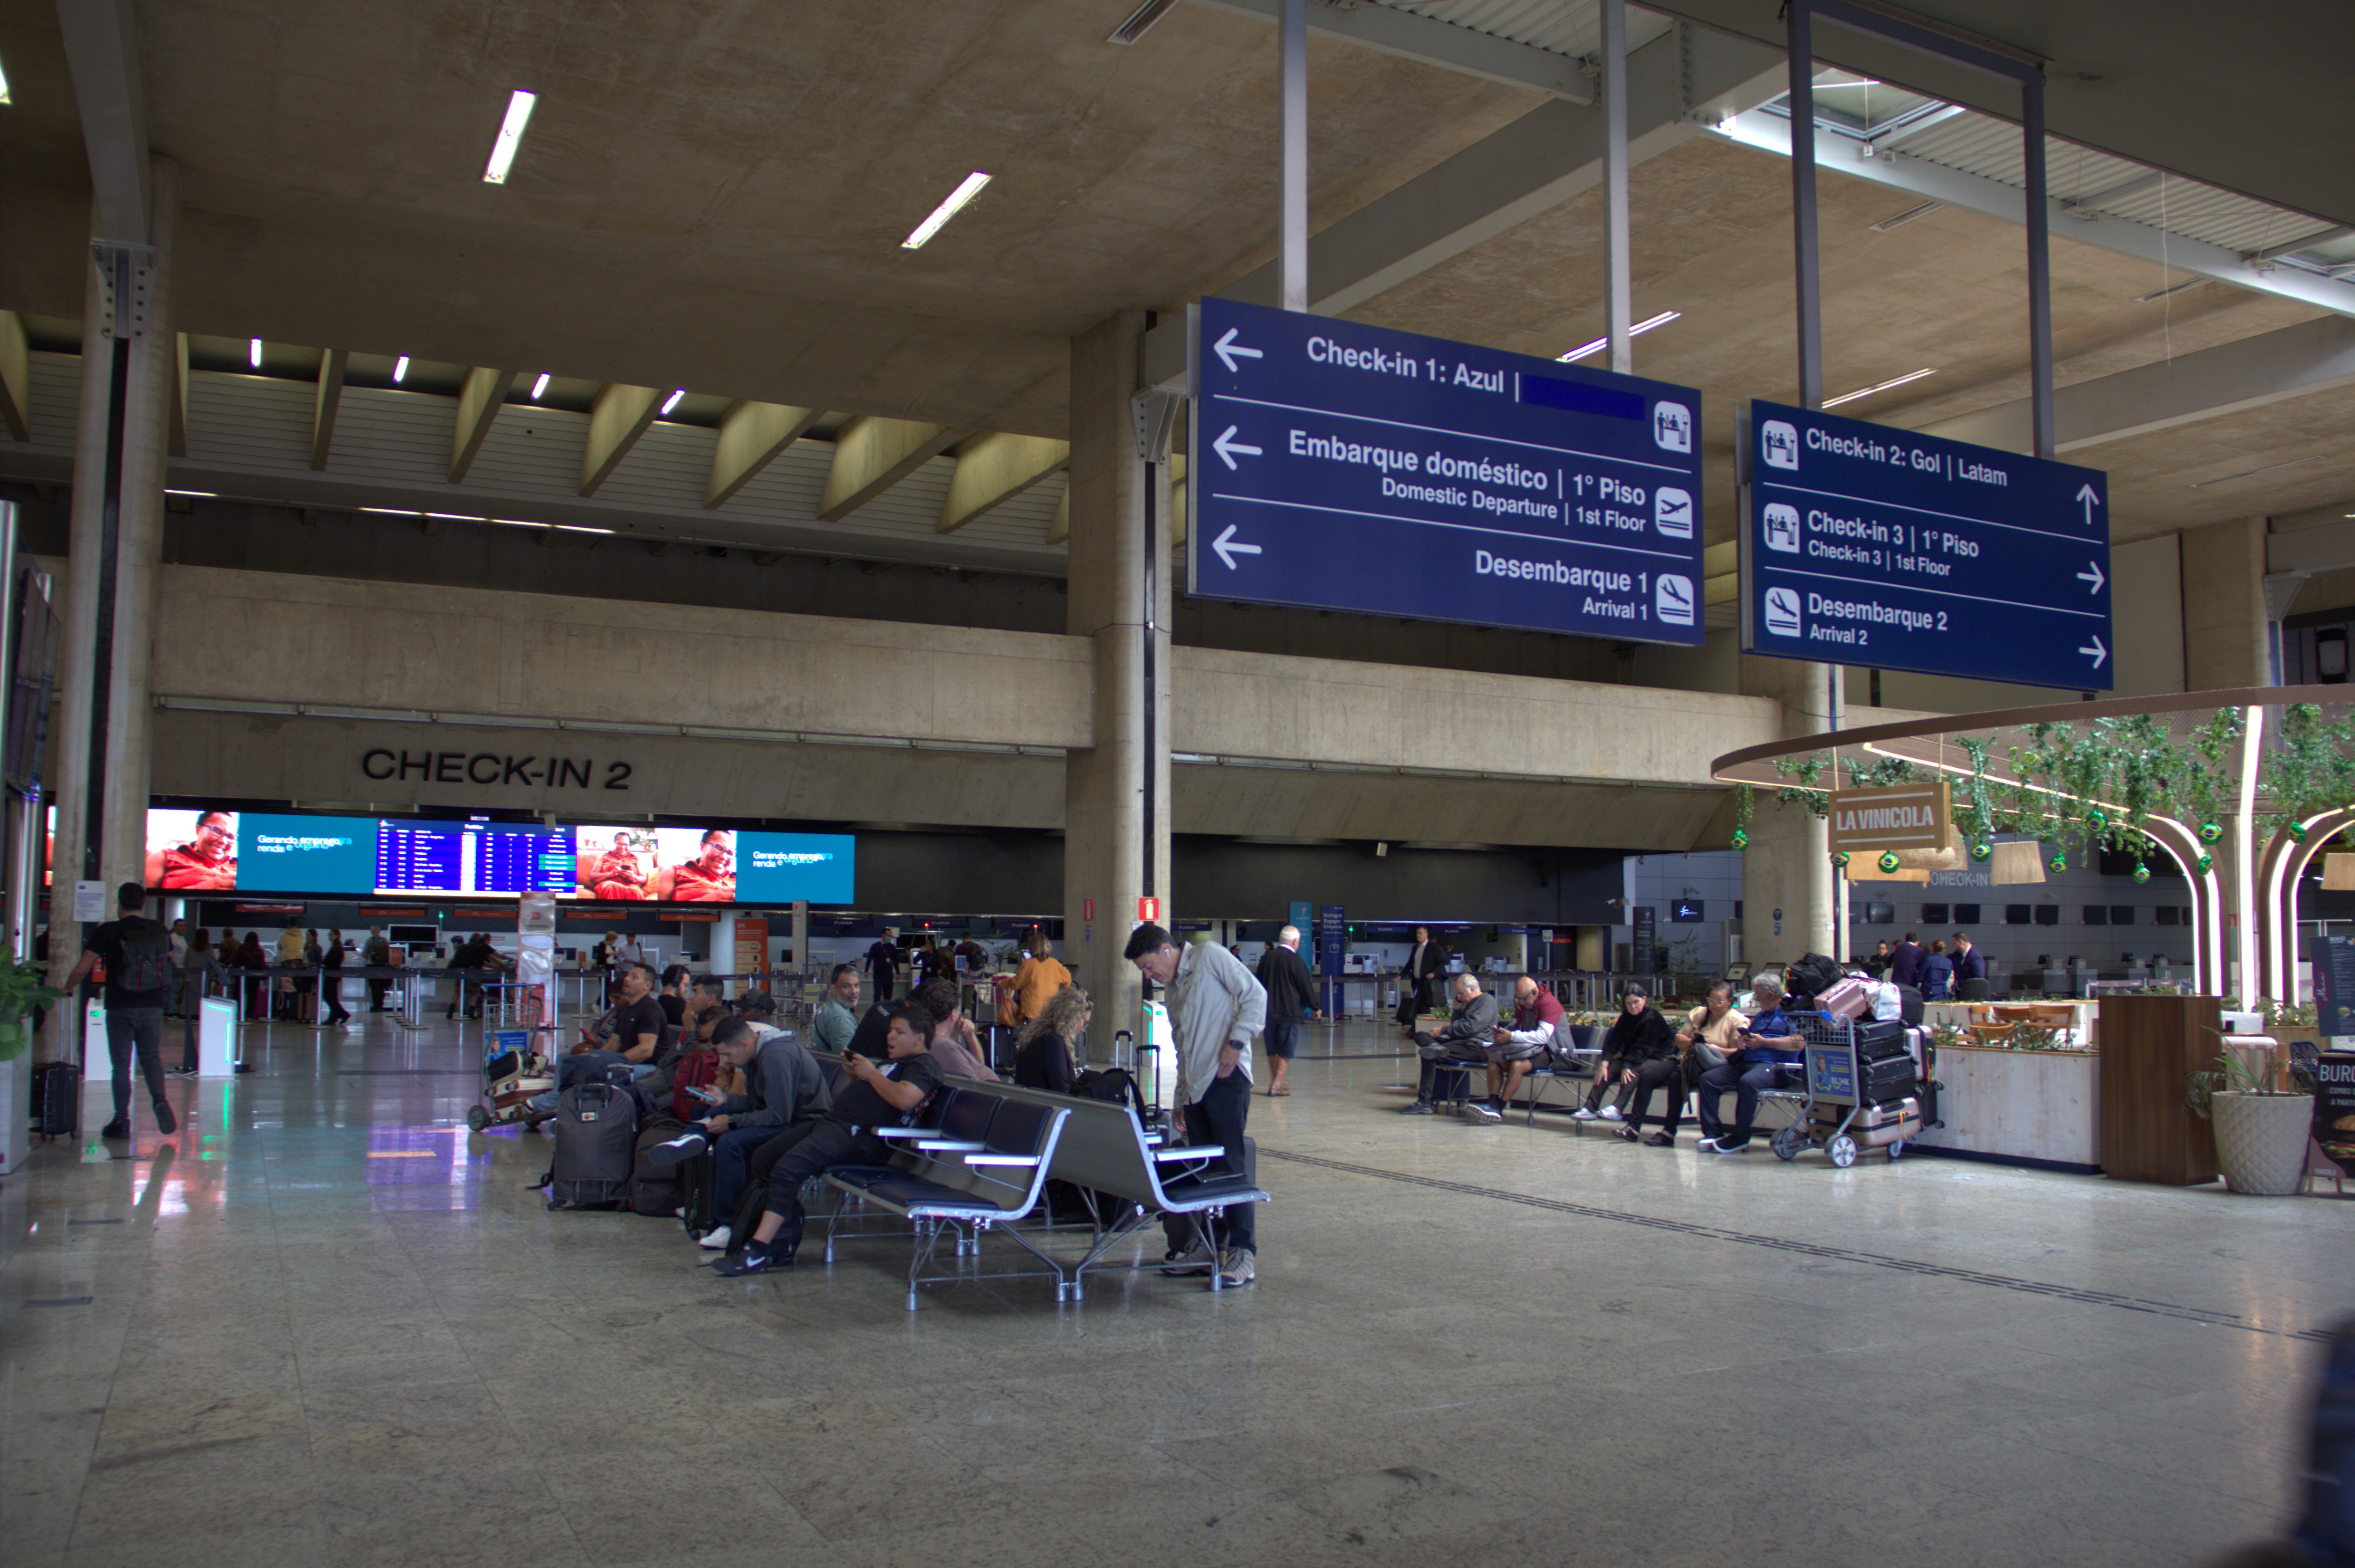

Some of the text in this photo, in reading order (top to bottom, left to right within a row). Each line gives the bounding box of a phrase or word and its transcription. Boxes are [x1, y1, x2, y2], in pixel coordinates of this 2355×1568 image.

[1307, 336, 1504, 393] Check-in 1: Azul
[1290, 430, 1418, 472] Embarque
[1426, 452, 1547, 490] doméstico
[1600, 478, 1646, 505] Piso
[1806, 428, 2007, 486] Check-in 2: Gol Latam
[1383, 478, 1646, 531] Domestic Departure 1st Floor
[1808, 510, 1888, 542] Check-in
[1893, 525, 1904, 545] 3
[1943, 533, 1979, 557] Piso
[1476, 550, 1647, 594] Desembarque 1
[1809, 540, 1951, 576] Check-in 3 1st Floor
[1583, 597, 1647, 621] Arrival 1
[1809, 593, 1948, 631] Desembarque 2
[1809, 624, 1867, 645] Arrival 2
[363, 749, 632, 790] CHECK-IN 2
[1836, 806, 1934, 831] LA VINICOLA
[257, 845, 285, 853] renda
